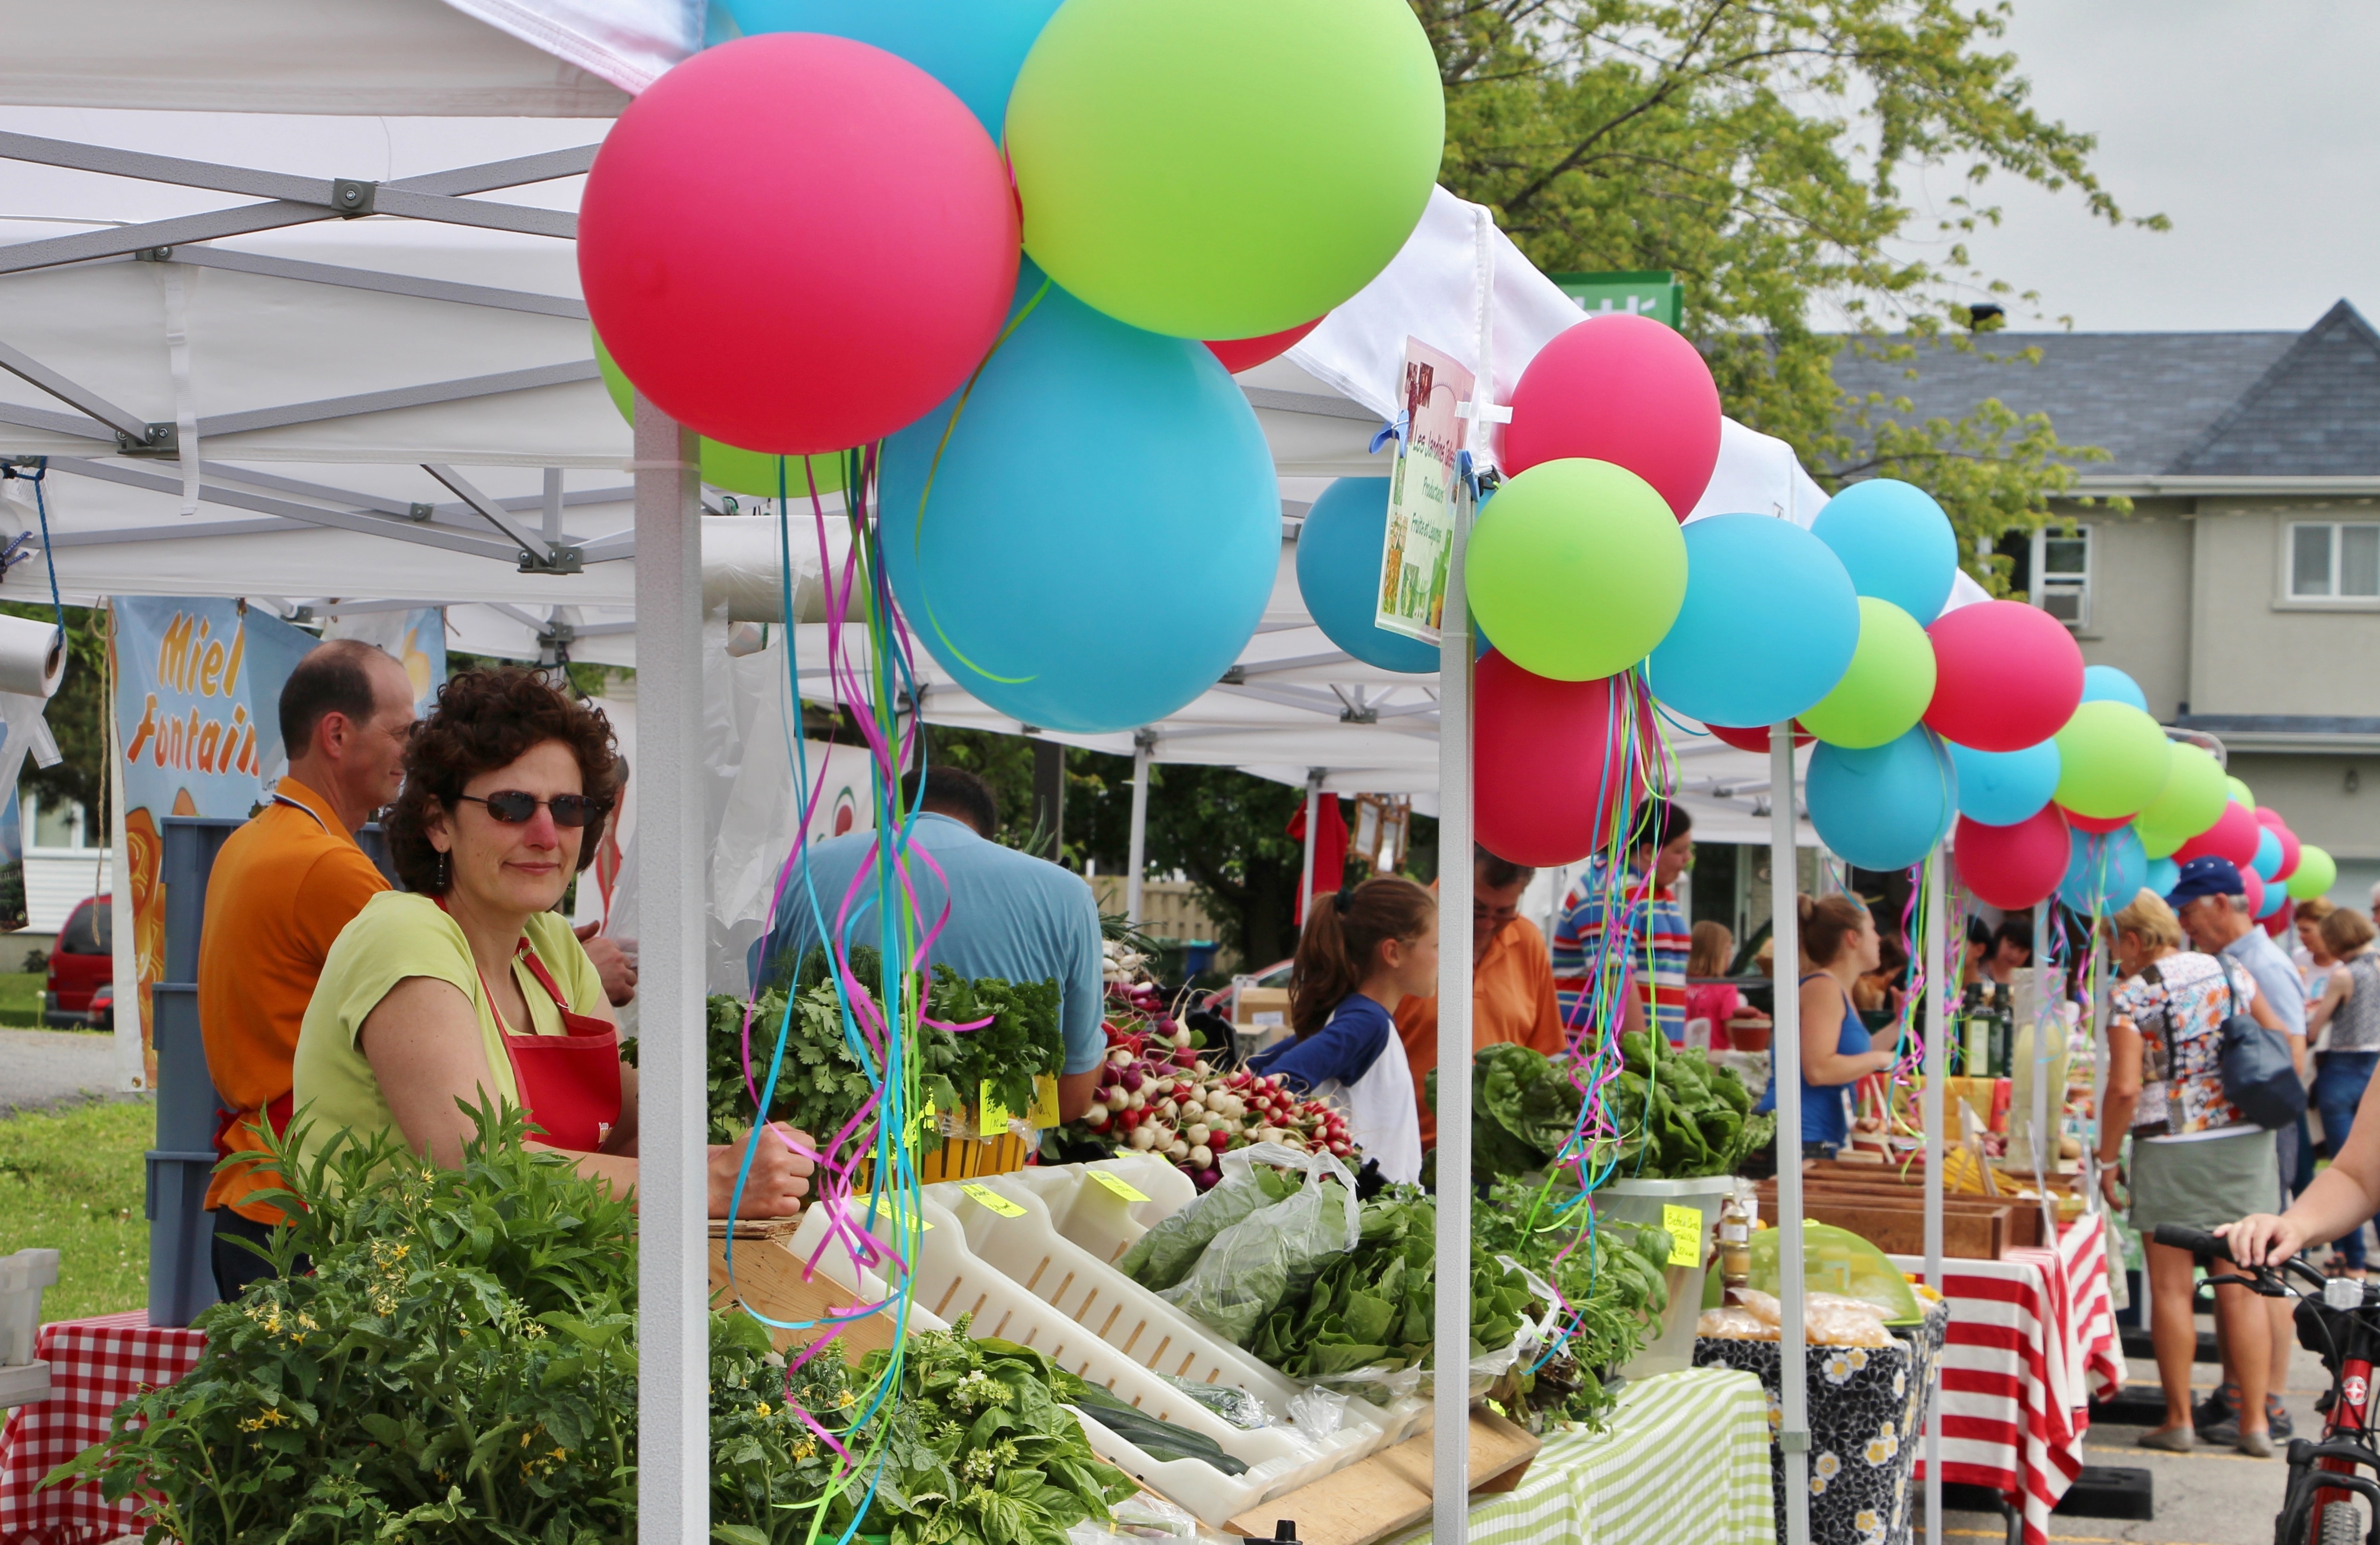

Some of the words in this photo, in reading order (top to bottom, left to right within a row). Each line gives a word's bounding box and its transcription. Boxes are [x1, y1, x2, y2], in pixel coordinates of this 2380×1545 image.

[1413, 424, 1425, 454] Les
[1425, 430, 1445, 463] Jardins
[157, 610, 245, 698] Miel
